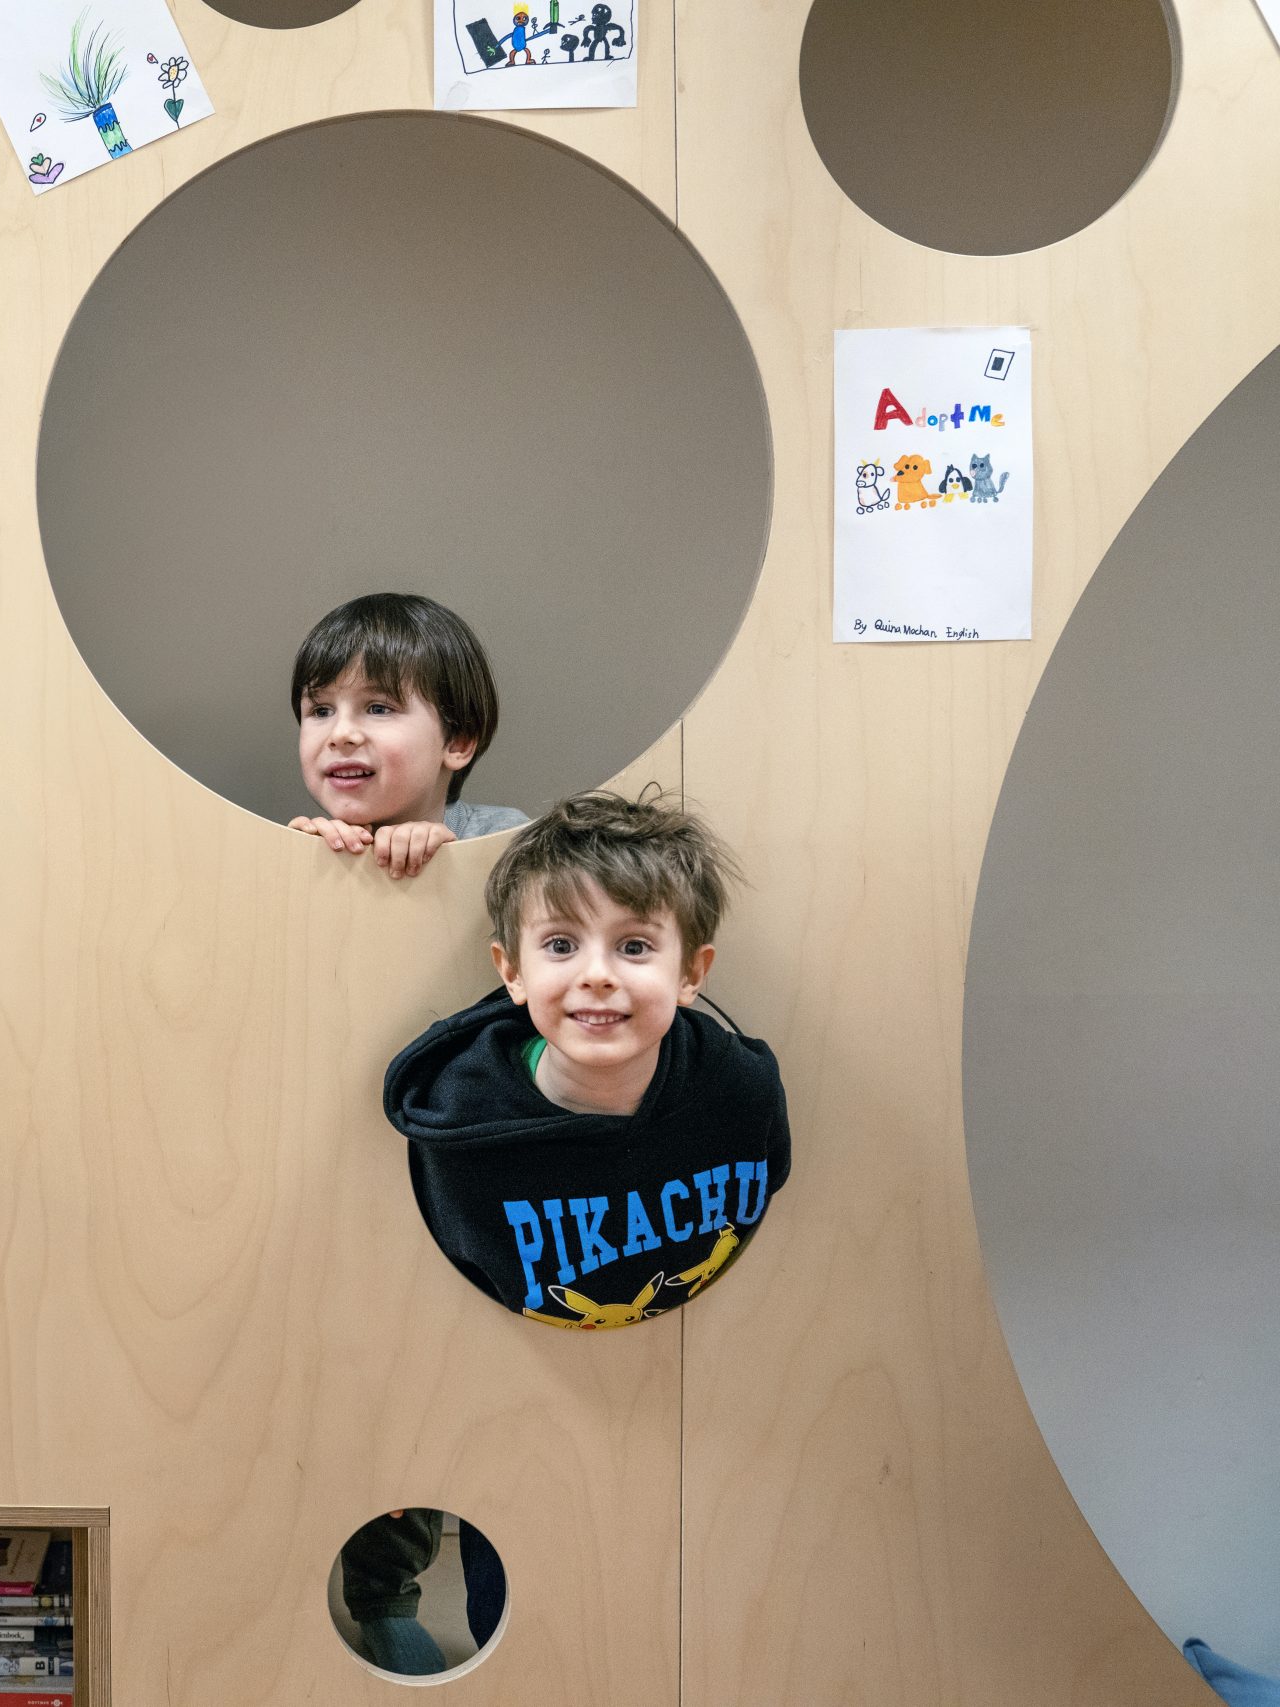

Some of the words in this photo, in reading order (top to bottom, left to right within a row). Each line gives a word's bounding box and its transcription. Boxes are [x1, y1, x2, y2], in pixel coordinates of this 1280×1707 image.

[873, 387, 964, 432] Adopt
[967, 404, 1005, 426] Me
[853, 618, 867, 634] By
[945, 626, 980, 640] English
[503, 1158, 768, 1309] PIKACHU
